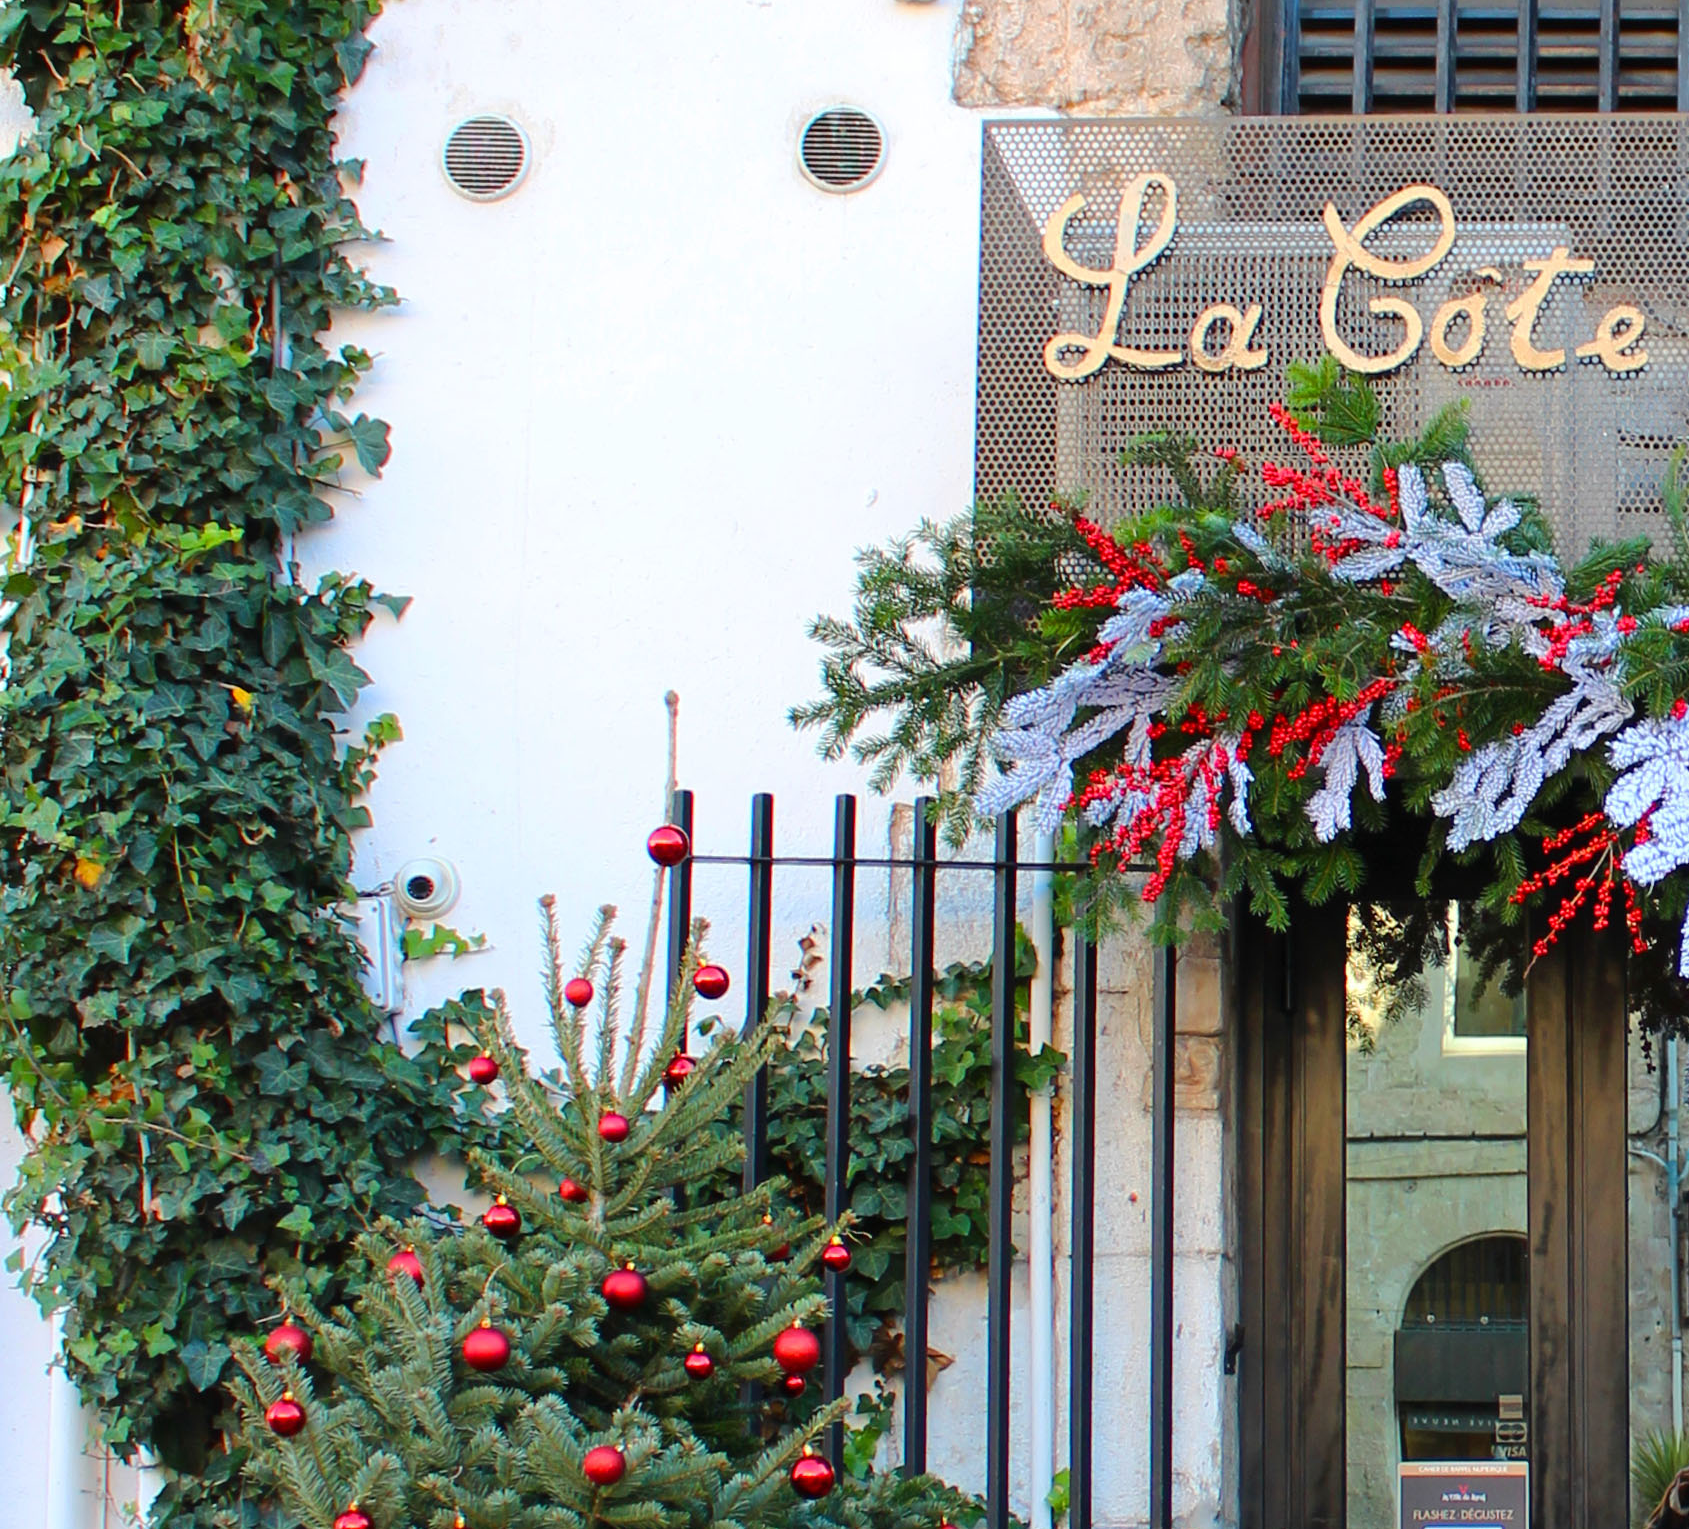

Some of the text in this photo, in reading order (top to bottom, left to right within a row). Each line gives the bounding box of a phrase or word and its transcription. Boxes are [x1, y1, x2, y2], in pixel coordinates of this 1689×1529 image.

[1043, 171, 1269, 382] La
[1499, 1445, 1527, 1458] VISA
[1412, 1507, 1515, 1521] FLASHEZ DÉGUSTEZ
